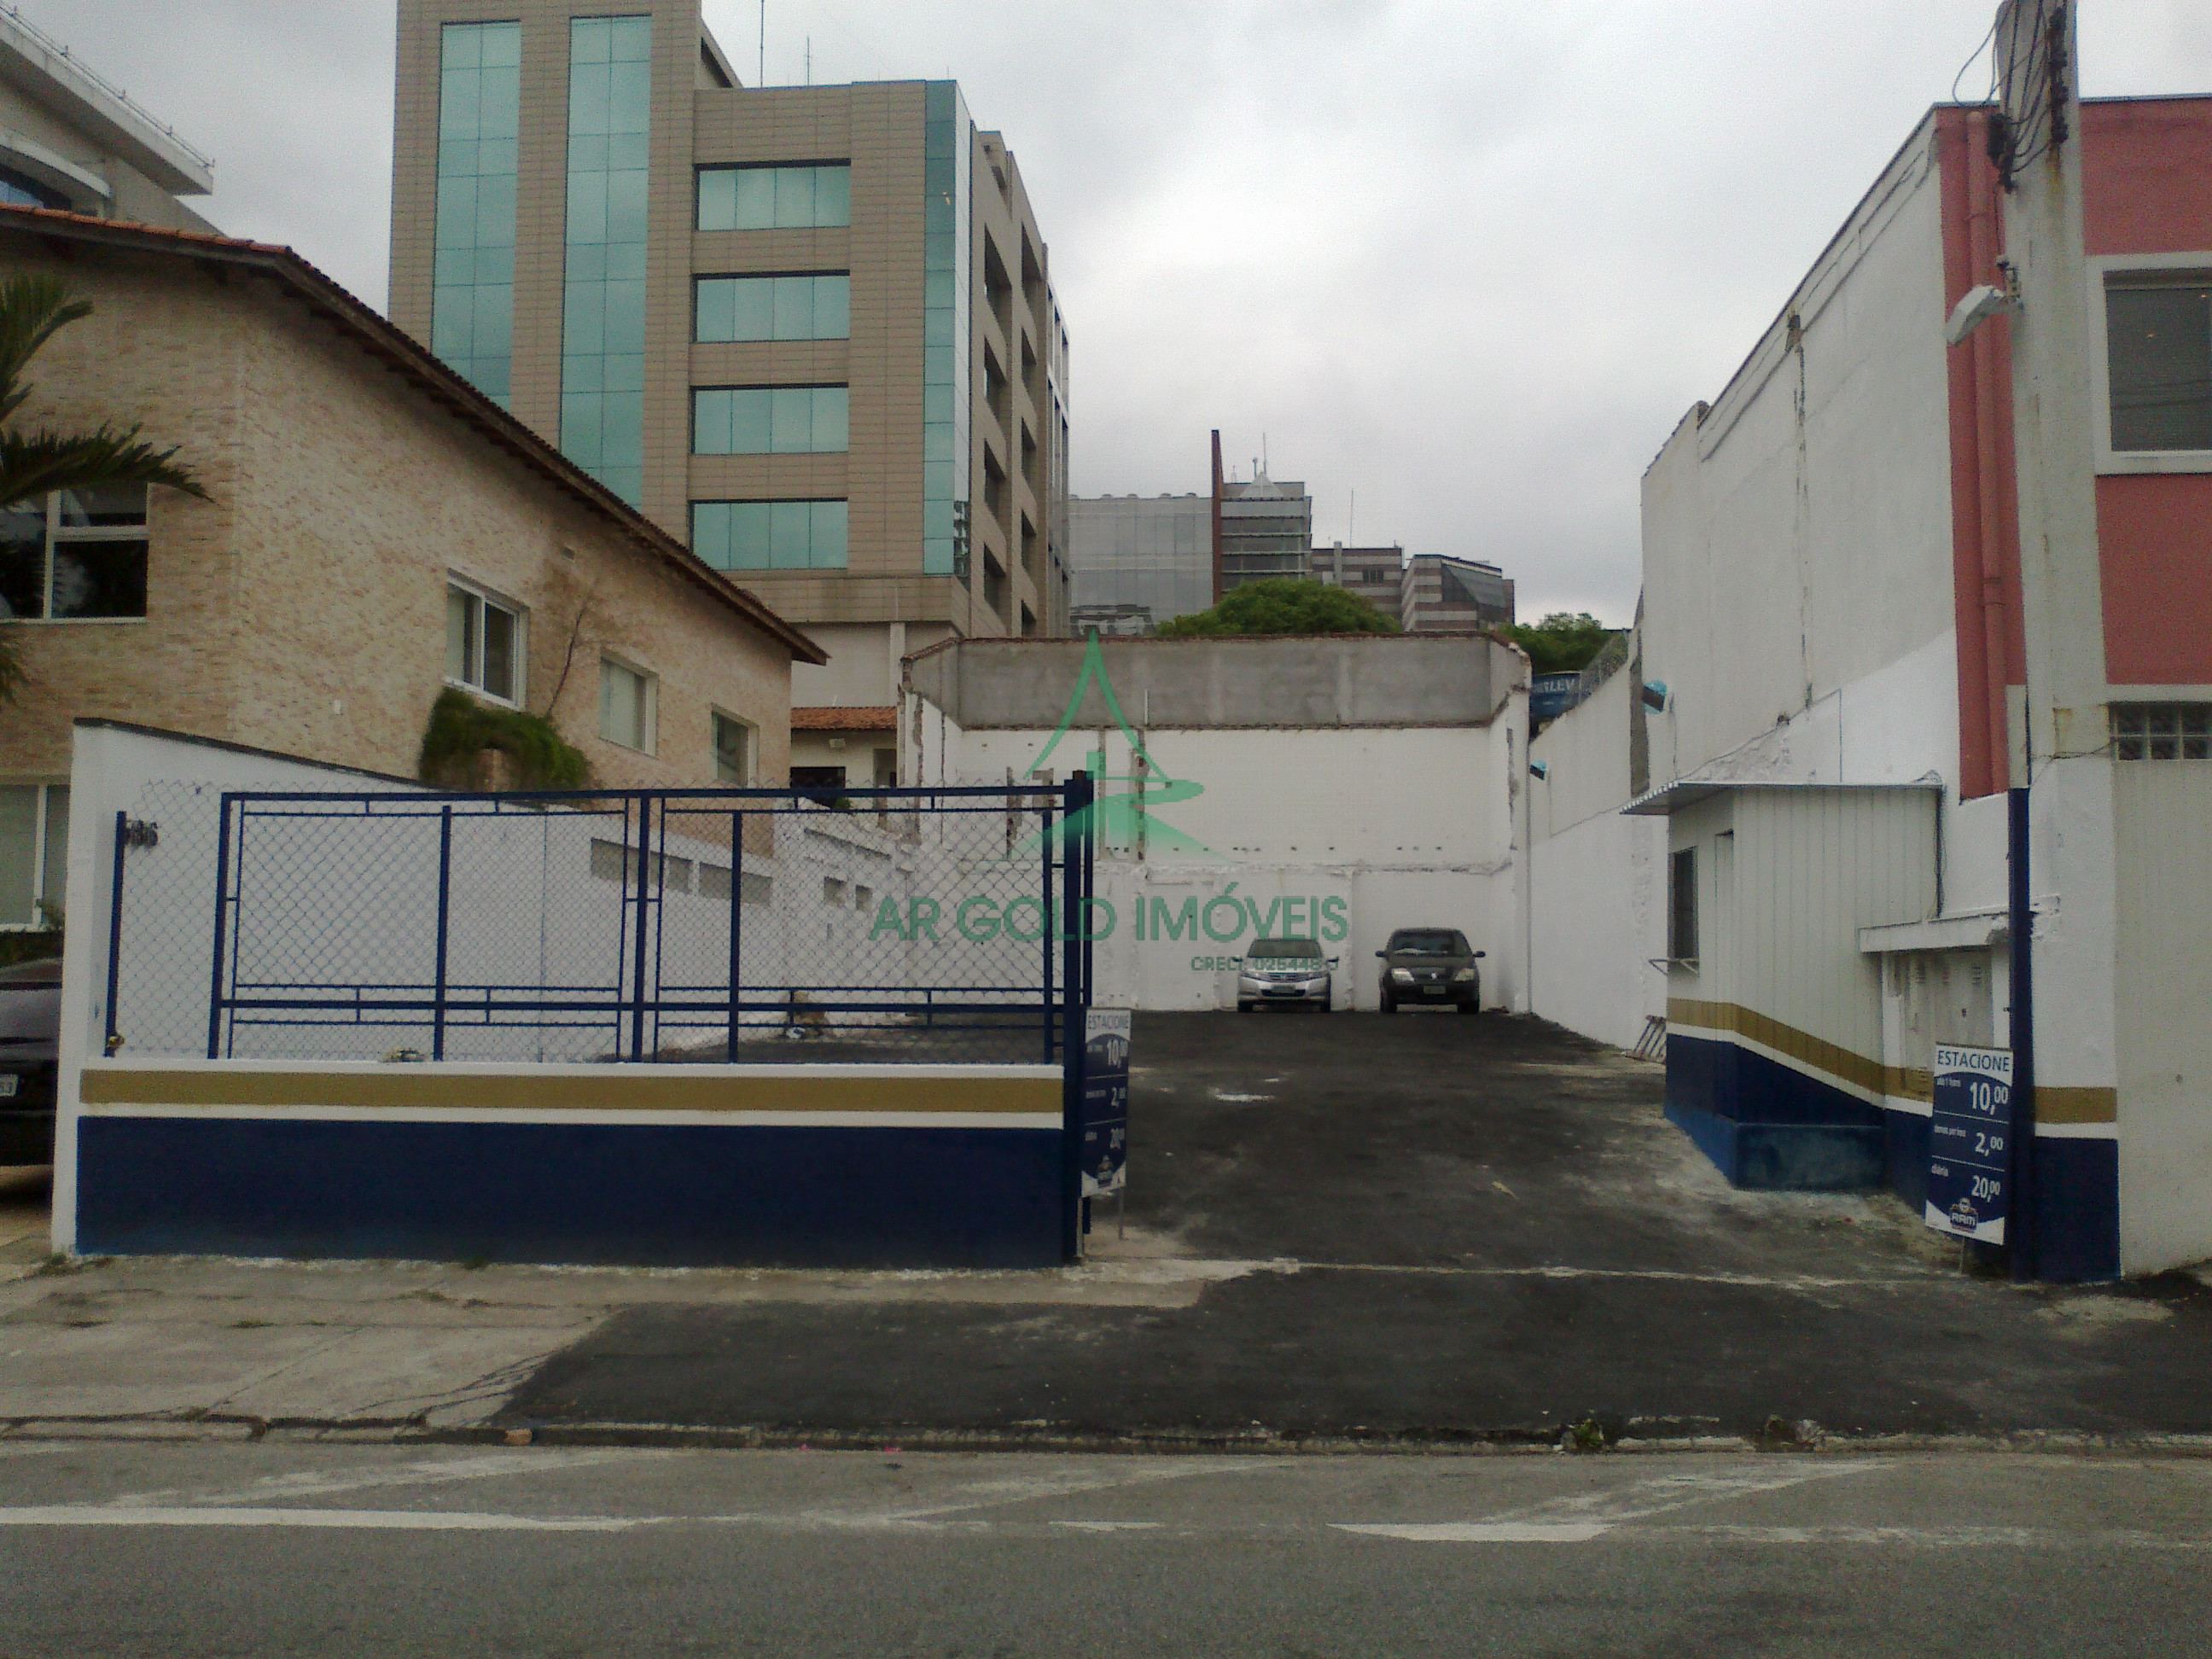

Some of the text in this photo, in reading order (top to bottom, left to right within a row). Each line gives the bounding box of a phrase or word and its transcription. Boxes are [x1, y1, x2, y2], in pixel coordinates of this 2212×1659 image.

[1088, 1014, 1129, 1030] ESTACIONE
[1937, 1050, 2010, 1072] ESTACIONE
[1970, 1082, 2009, 1115] 10,00
[1976, 1132, 2004, 1157] 2,00
[1971, 1174, 2001, 1203] 20,00
